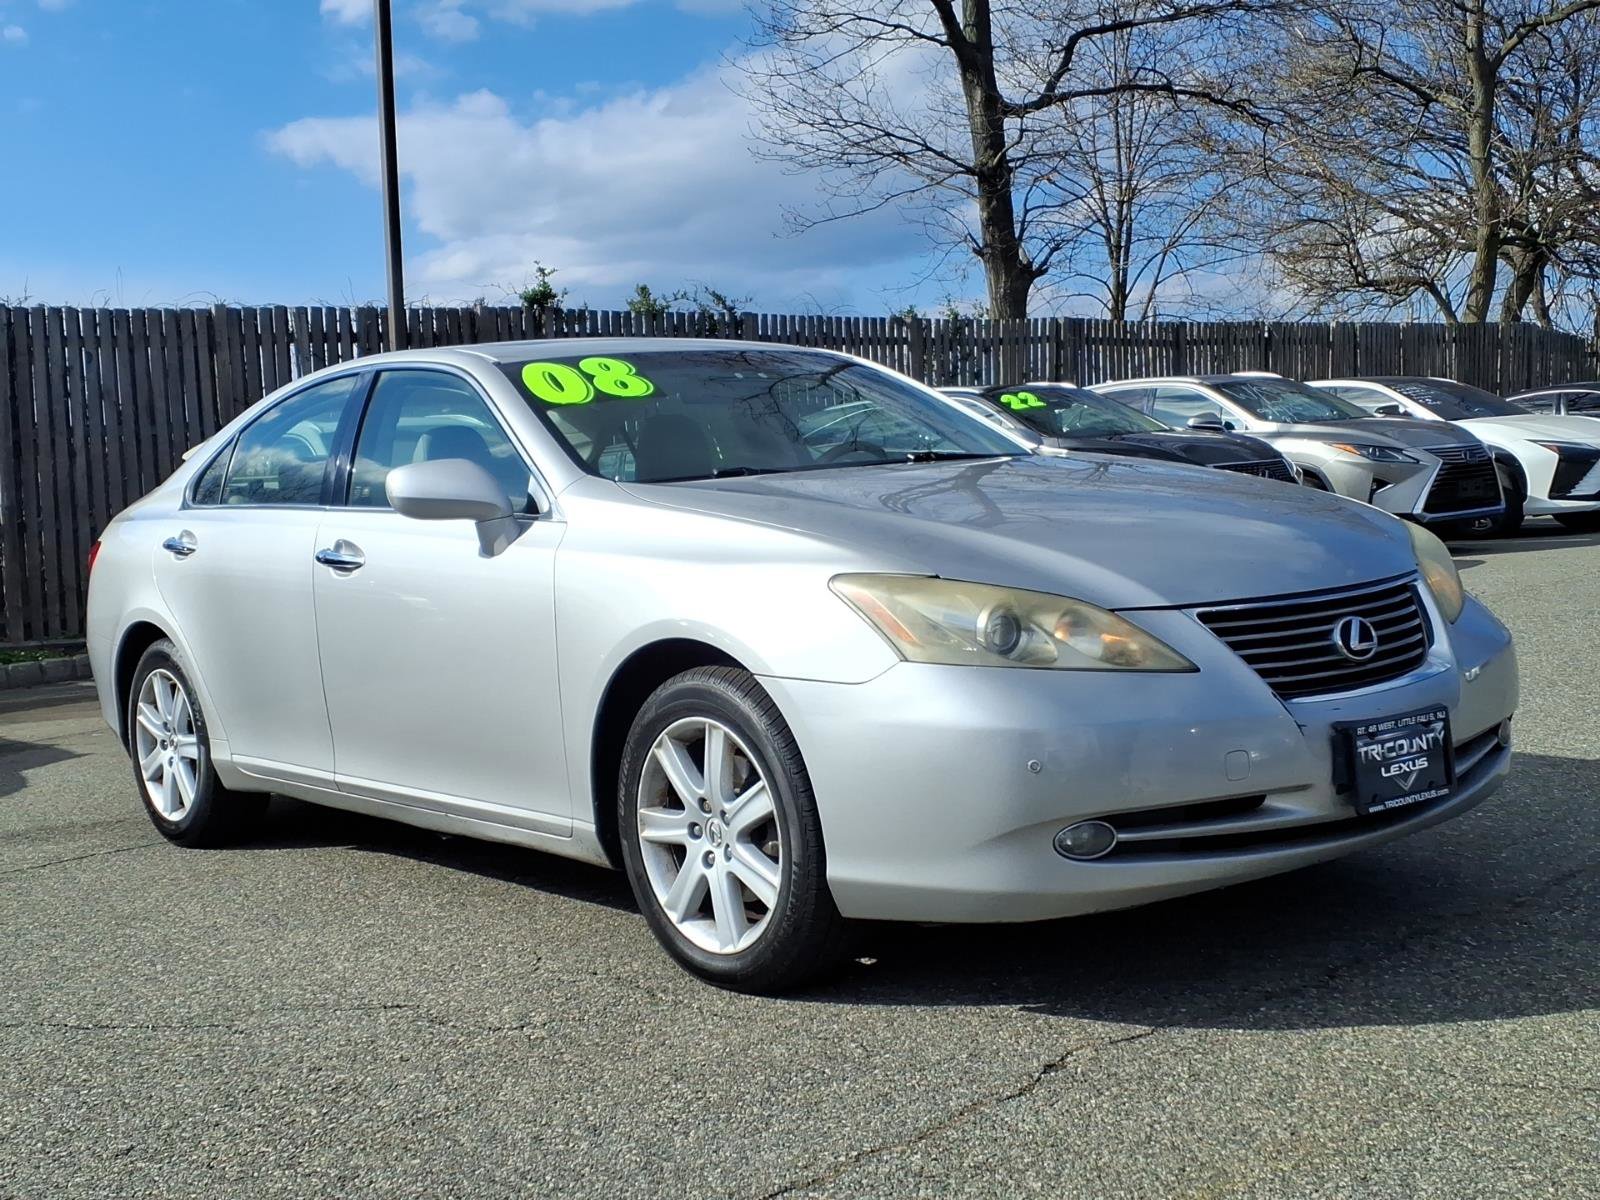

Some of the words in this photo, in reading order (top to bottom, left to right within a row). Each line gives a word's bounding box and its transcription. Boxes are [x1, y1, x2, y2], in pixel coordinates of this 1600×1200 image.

[521, 357, 654, 405] 08
[1000, 391, 1047, 410] 22
[1397, 716, 1417, 727] LITTLE
[1381, 757, 1428, 777] LEXUS
[1368, 788, 1450, 813] www.TRICOUNTYLEXUS.com
